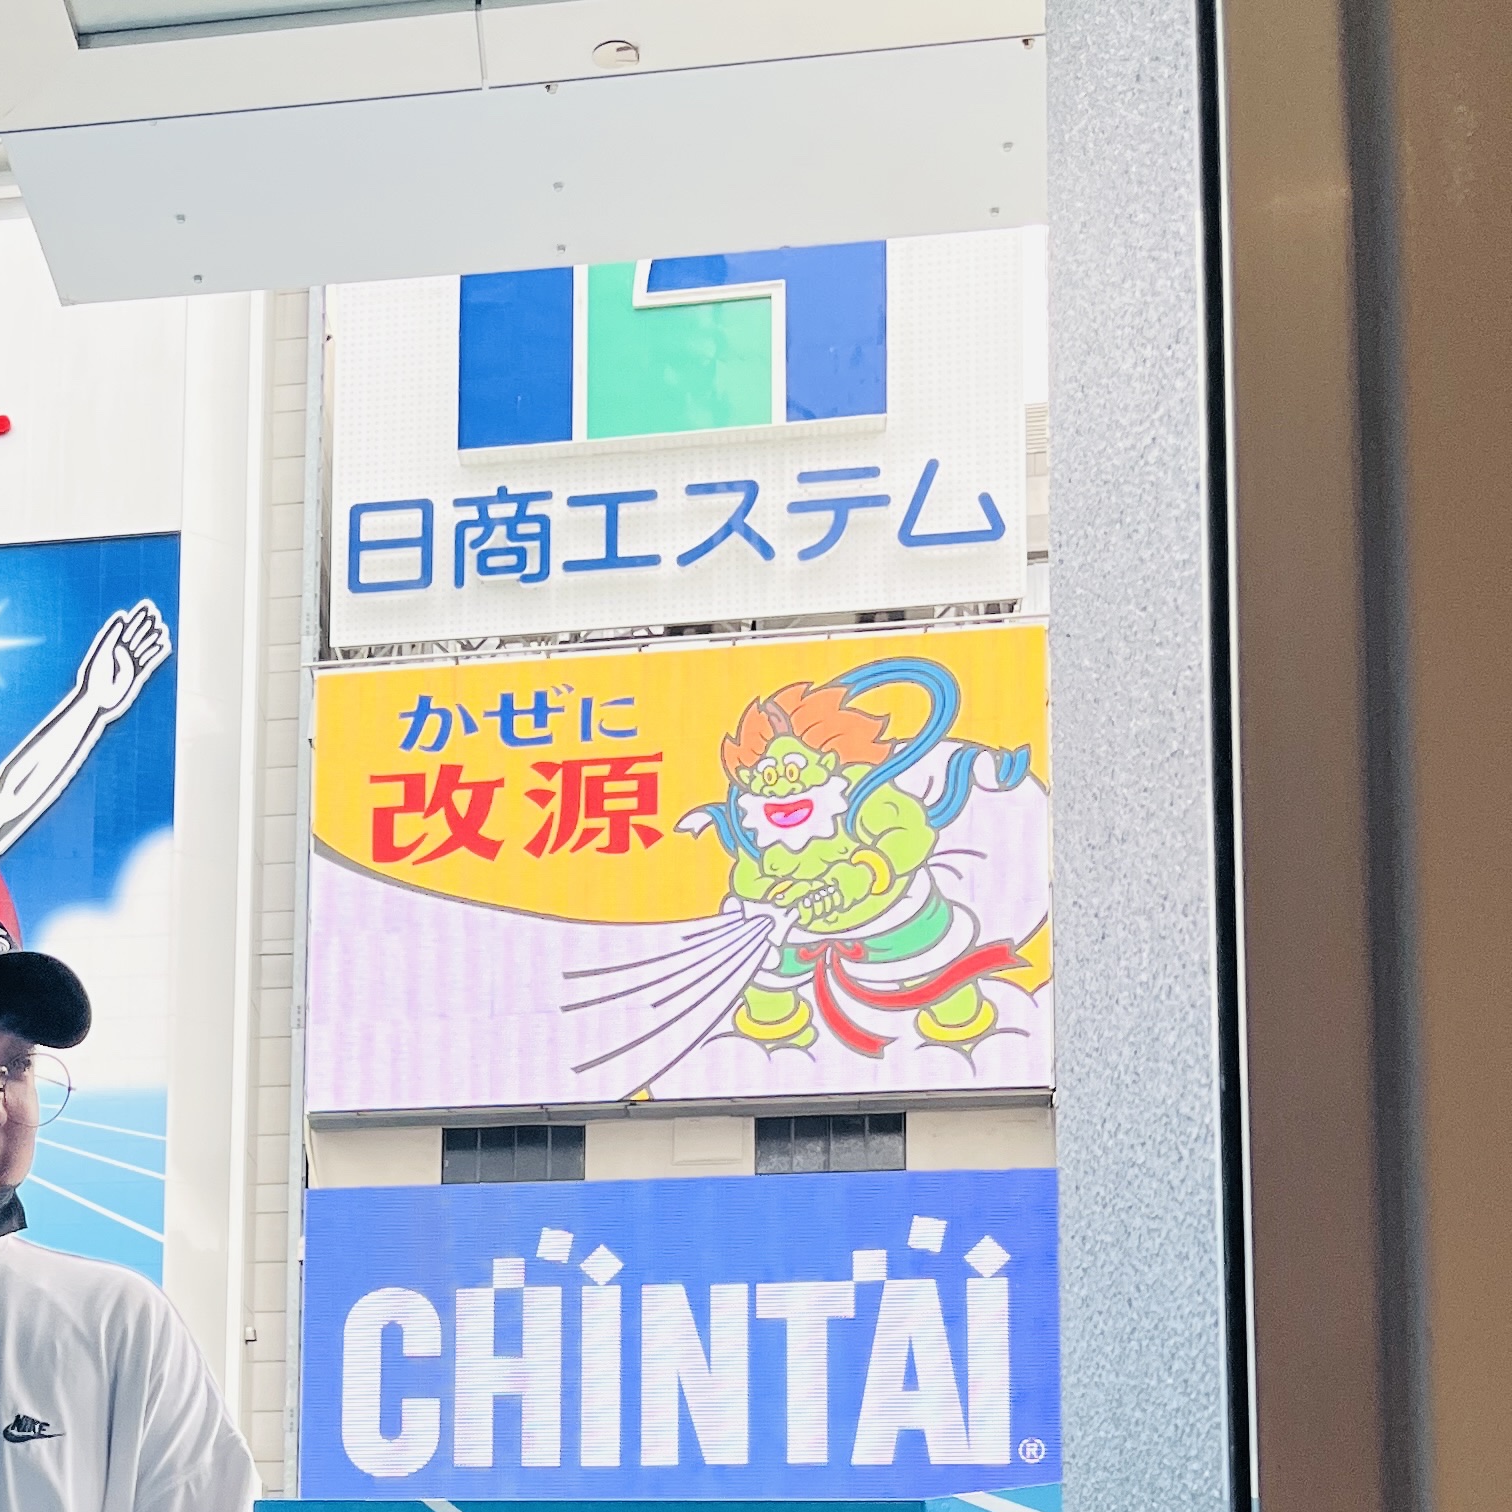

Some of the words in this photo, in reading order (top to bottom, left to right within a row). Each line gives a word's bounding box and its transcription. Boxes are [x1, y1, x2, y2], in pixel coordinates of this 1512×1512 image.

[346, 457, 1006, 593] 日商エステム
[397, 682, 639, 753] かぜに
[368, 750, 665, 866] 改源
[341, 1215, 1011, 1478] CHINTAI
